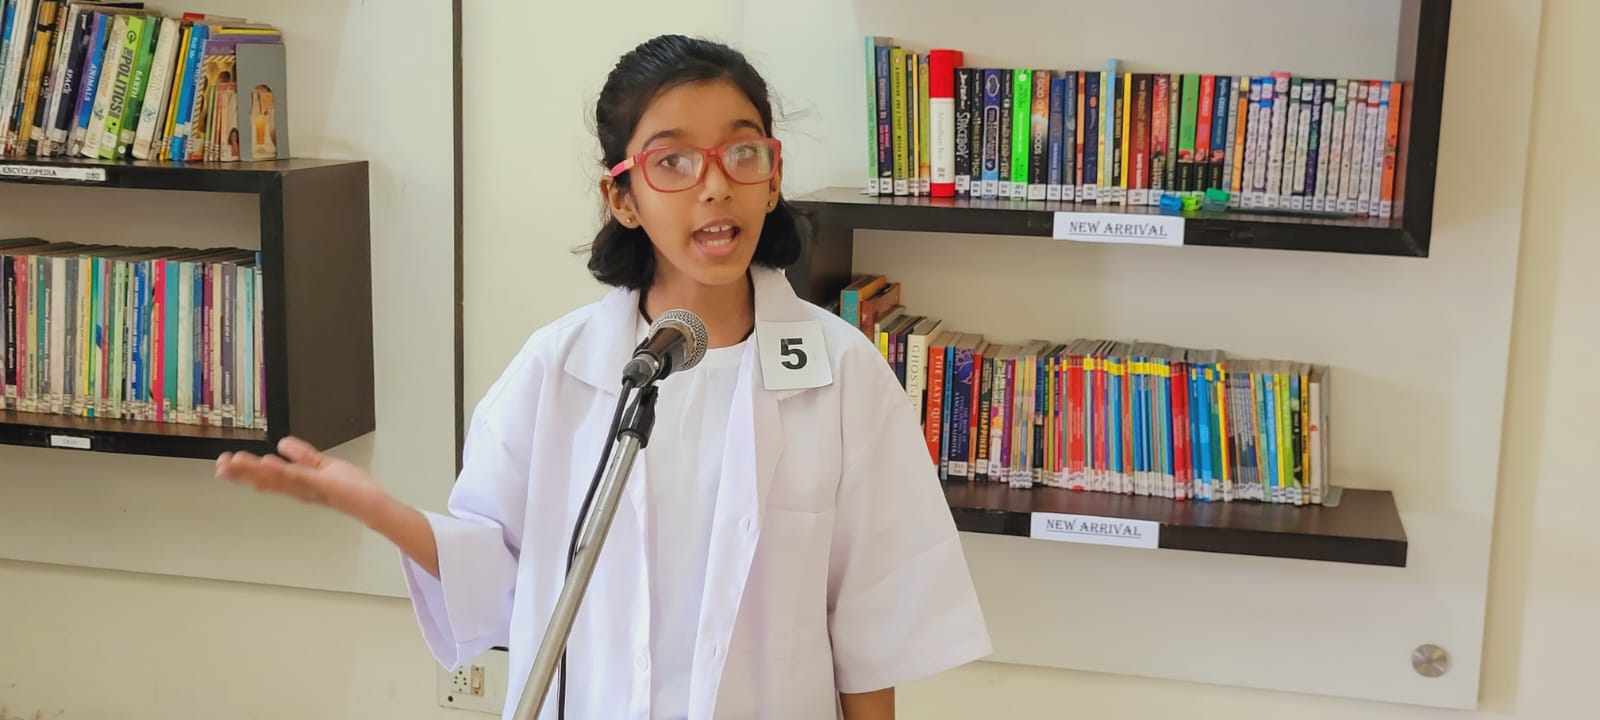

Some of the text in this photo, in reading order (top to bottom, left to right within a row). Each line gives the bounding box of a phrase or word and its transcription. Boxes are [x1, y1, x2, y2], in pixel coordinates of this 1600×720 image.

[189, 50, 196, 59] Me
[63, 69, 74, 94] SPACE
[84, 64, 97, 101] ANIMALS
[110, 55, 131, 114] POLITICS
[130, 70, 144, 99] EARTH
[956, 112, 971, 159] SPACEBOY
[2, 167, 57, 176] ENCYCLOPEDIA
[1069, 221, 1168, 237] NEW ARRIVAL
[780, 338, 807, 370] 5
[935, 355, 944, 374] THE
[933, 378, 942, 403] LAST
[930, 408, 940, 443] QUEEN
[980, 412, 989, 458] HAPPINESS
[1046, 519, 1142, 537] NEW ARRIVAL
